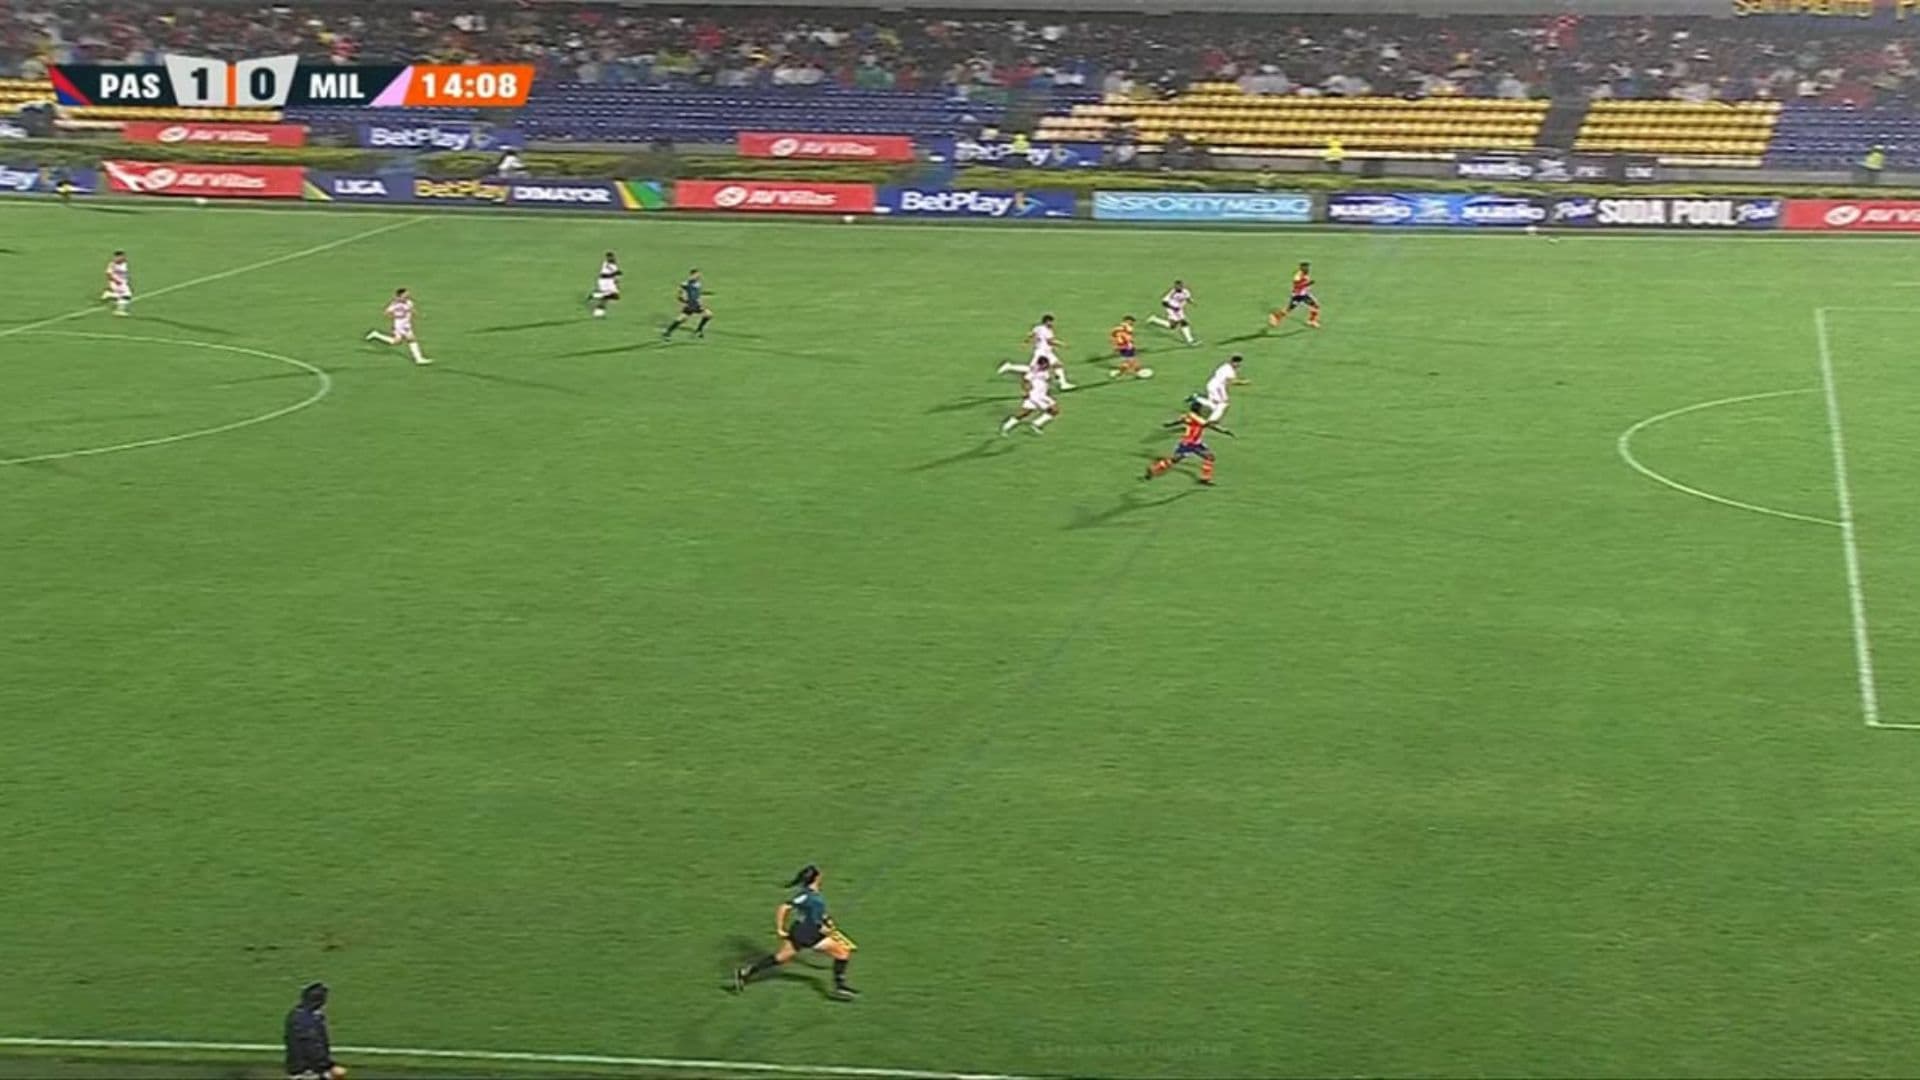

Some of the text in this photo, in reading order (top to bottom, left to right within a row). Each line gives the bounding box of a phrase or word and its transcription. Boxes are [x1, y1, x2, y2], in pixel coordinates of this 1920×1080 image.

[370, 126, 470, 151] BetPlay
[334, 178, 611, 203] LIGA BetPlay DIMAYOR
[900, 190, 1015, 217] BetPlay
[1597, 199, 1666, 223] SODA
[1671, 199, 1737, 226] POOL
